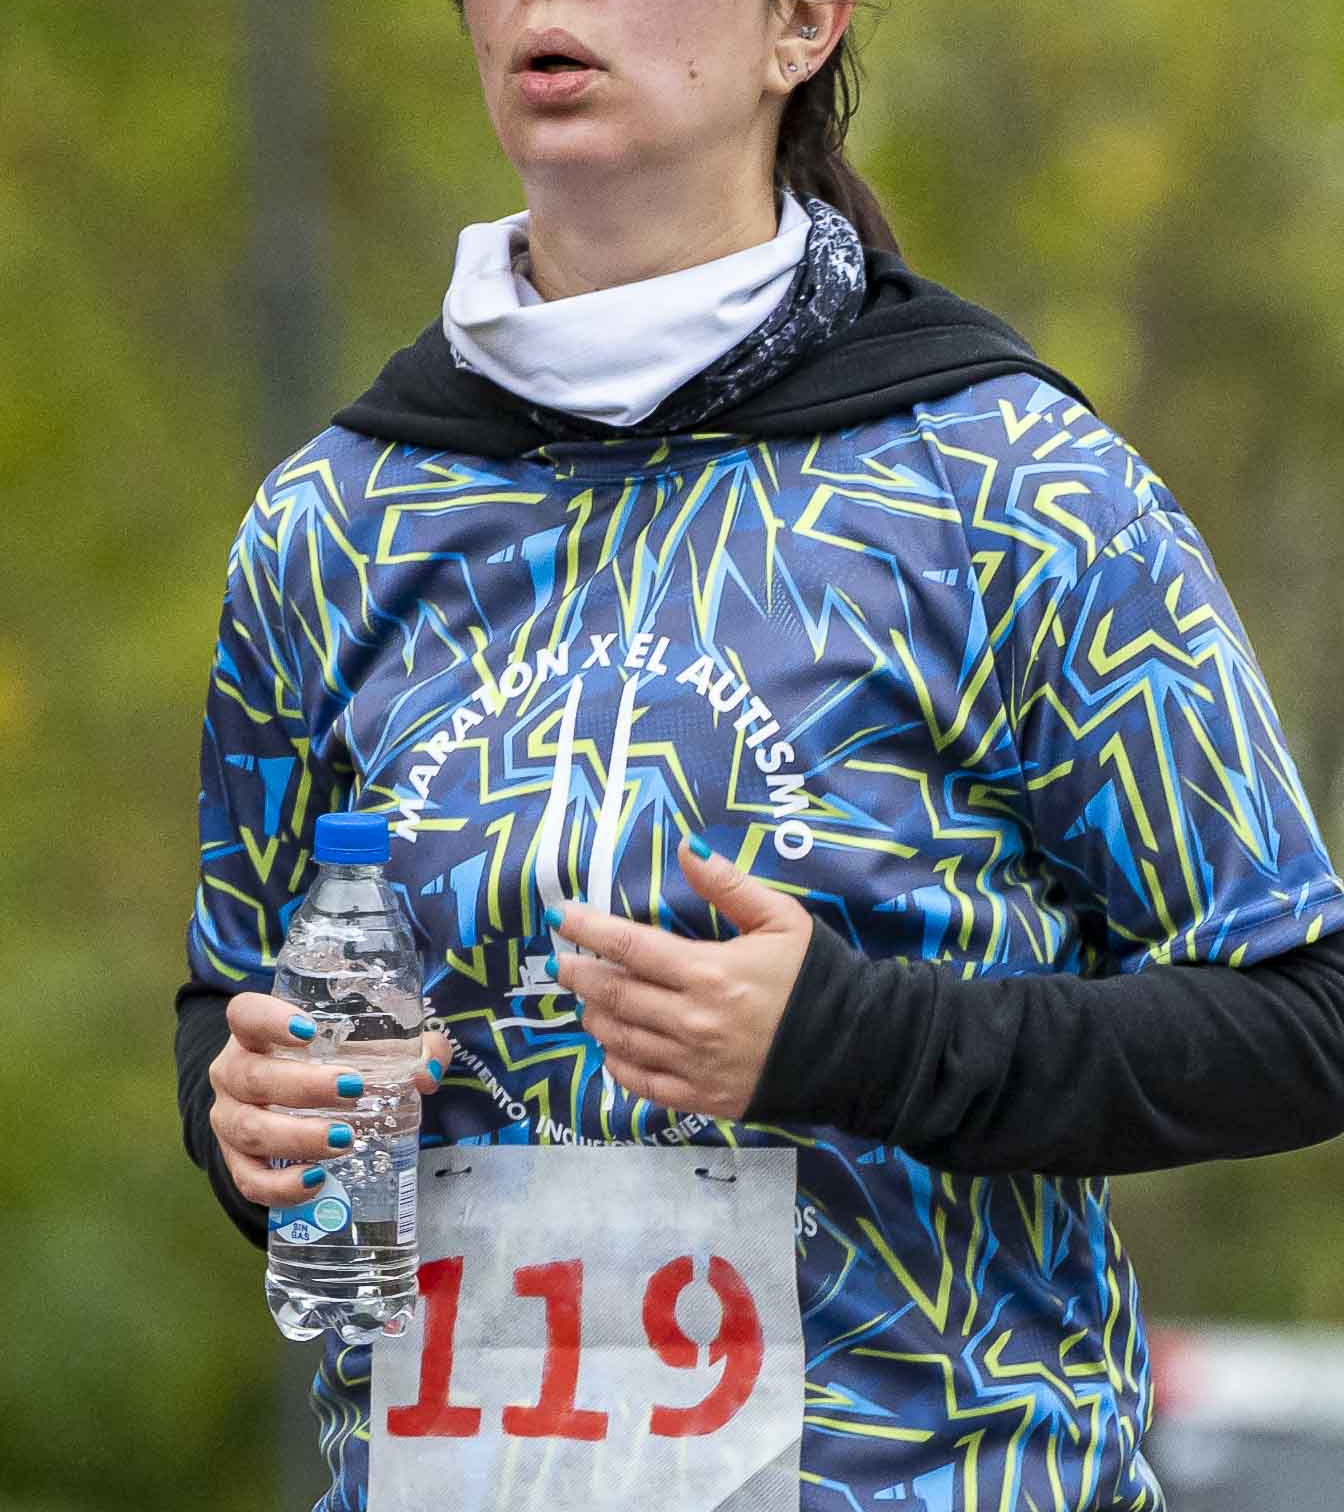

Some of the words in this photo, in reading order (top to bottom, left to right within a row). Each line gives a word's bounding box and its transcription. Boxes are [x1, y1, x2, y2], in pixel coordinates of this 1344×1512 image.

[580, 633, 618, 670] X
[623, 632, 671, 676] EL
[675, 654, 814, 861] AUTISMO
[387, 1255, 764, 1441] 119
